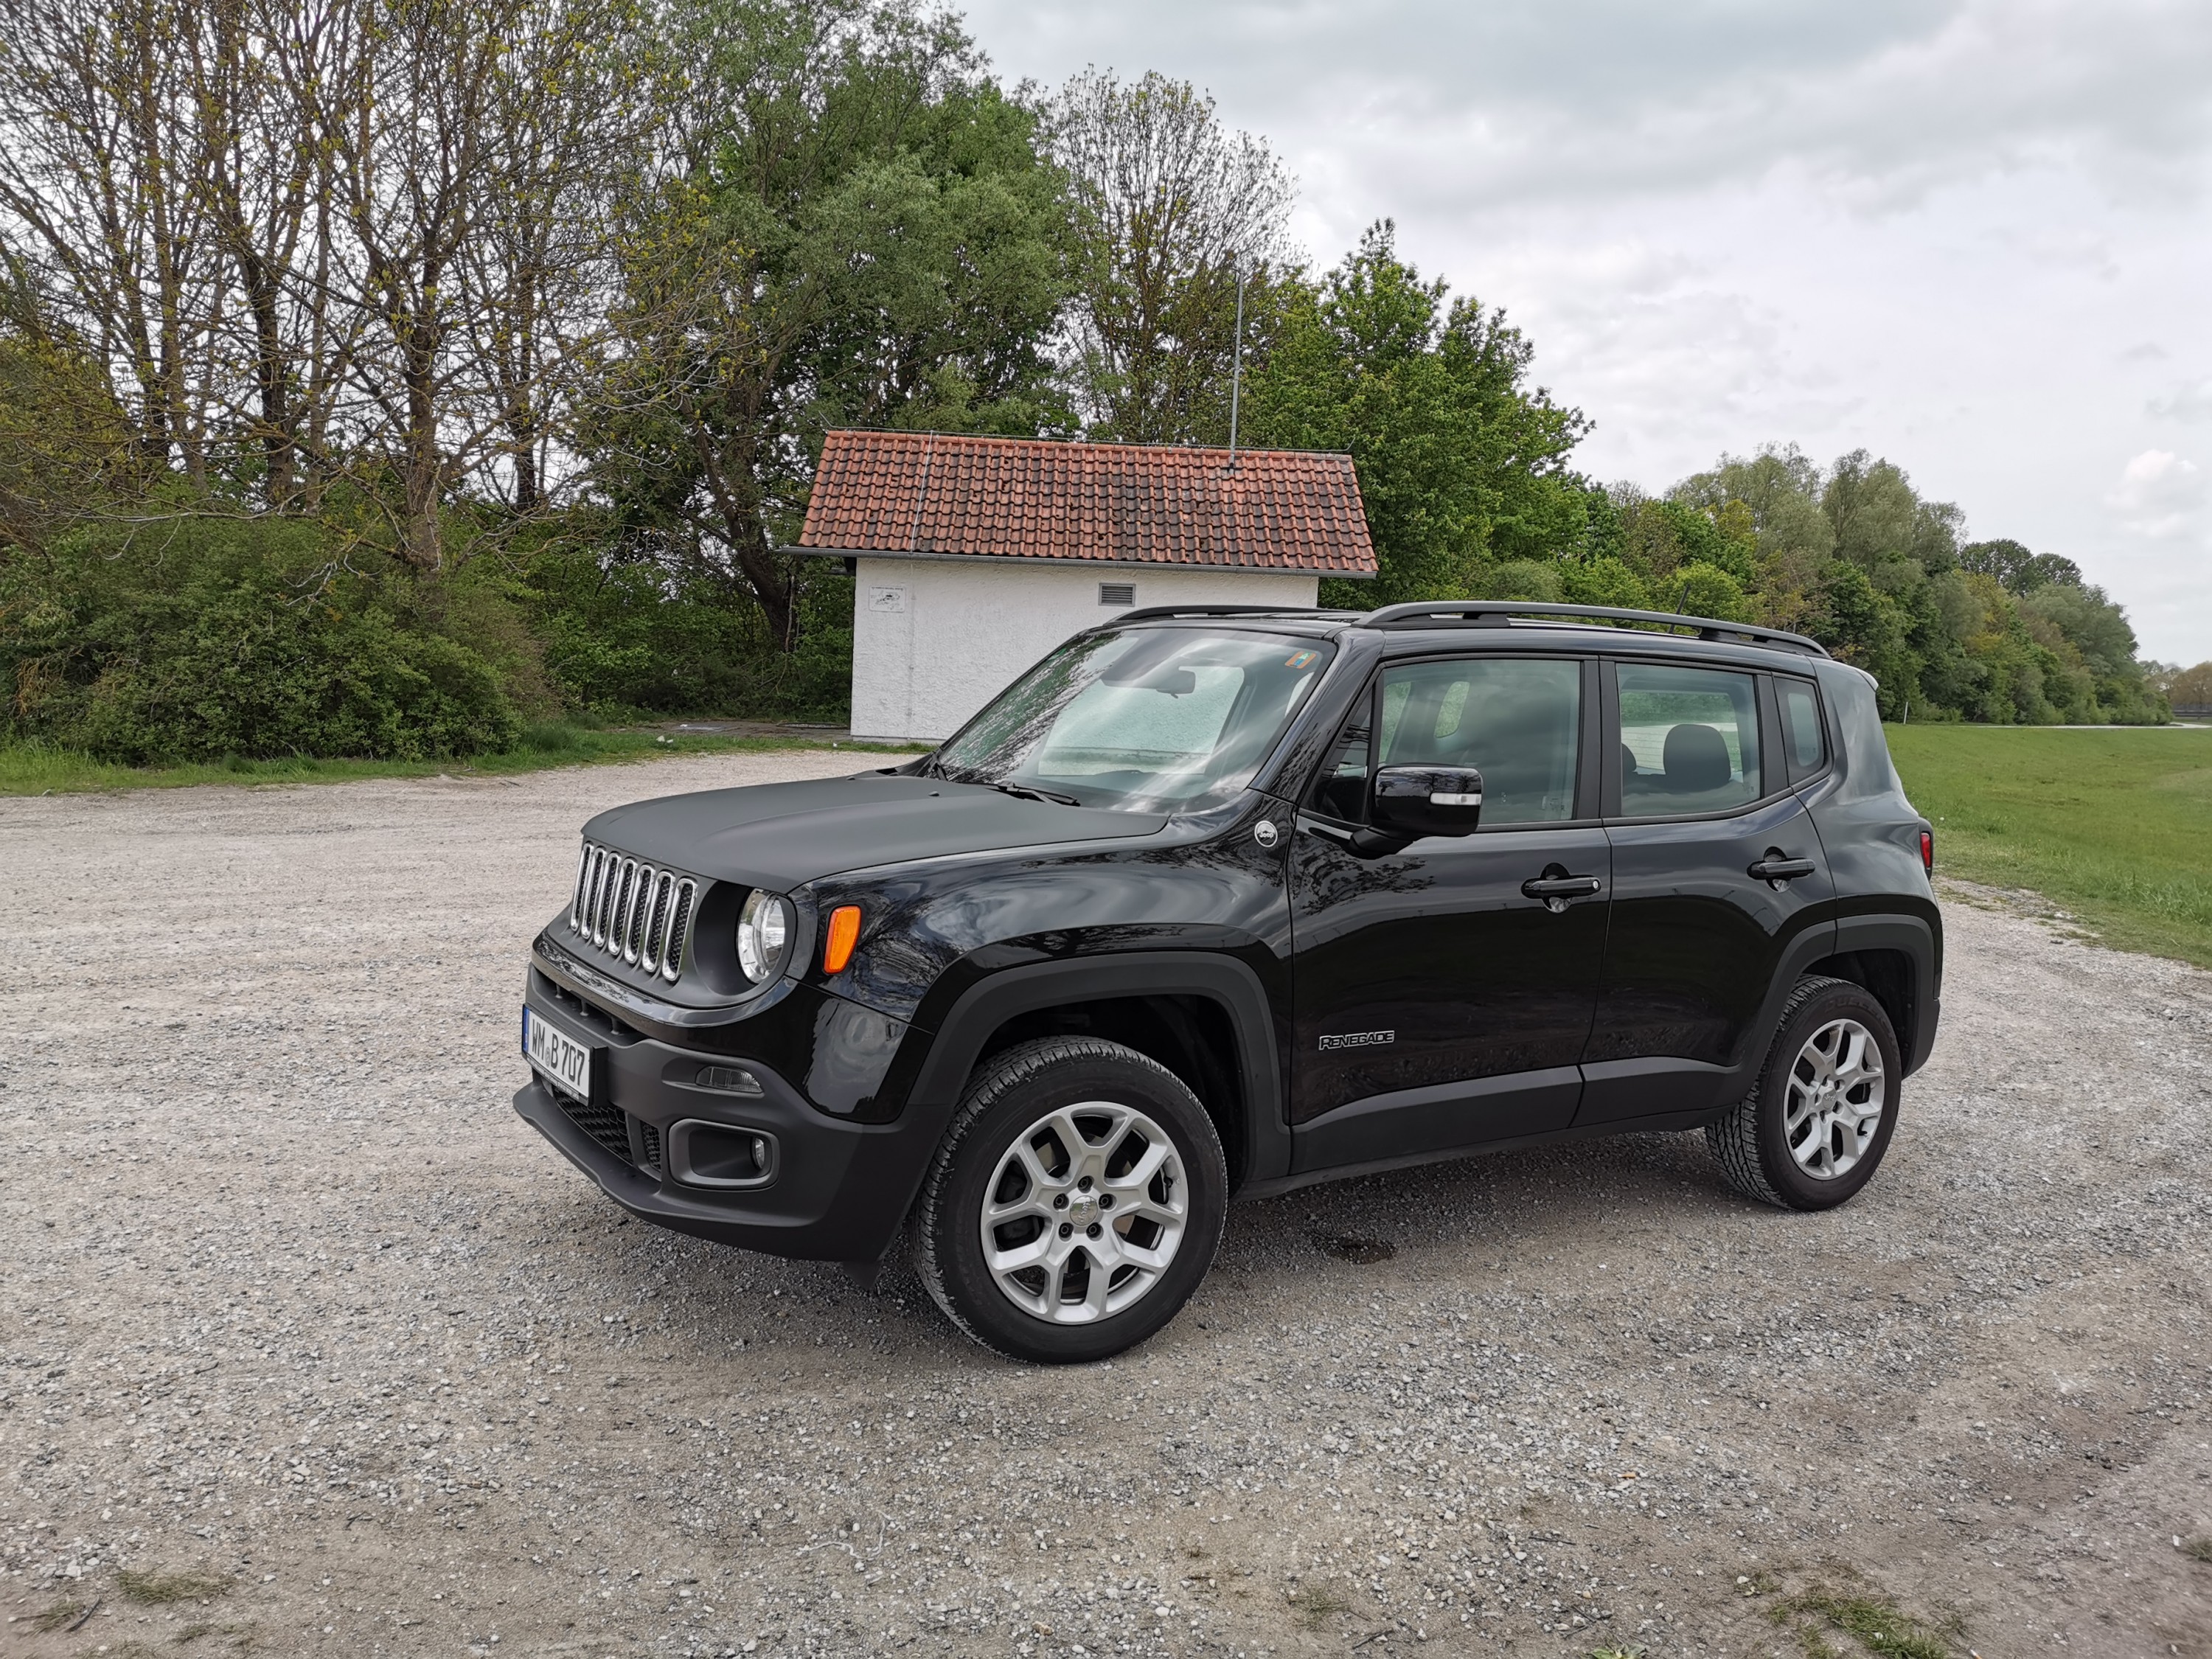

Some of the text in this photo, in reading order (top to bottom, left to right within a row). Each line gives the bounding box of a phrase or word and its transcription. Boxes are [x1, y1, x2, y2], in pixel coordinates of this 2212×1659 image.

[1259, 831, 1274, 839] Jeep
[1318, 1030, 1395, 1051] RENEGADE
[532, 1018, 546, 1060] WM
[550, 1033, 559, 1069] B
[562, 1040, 585, 1086] 707
